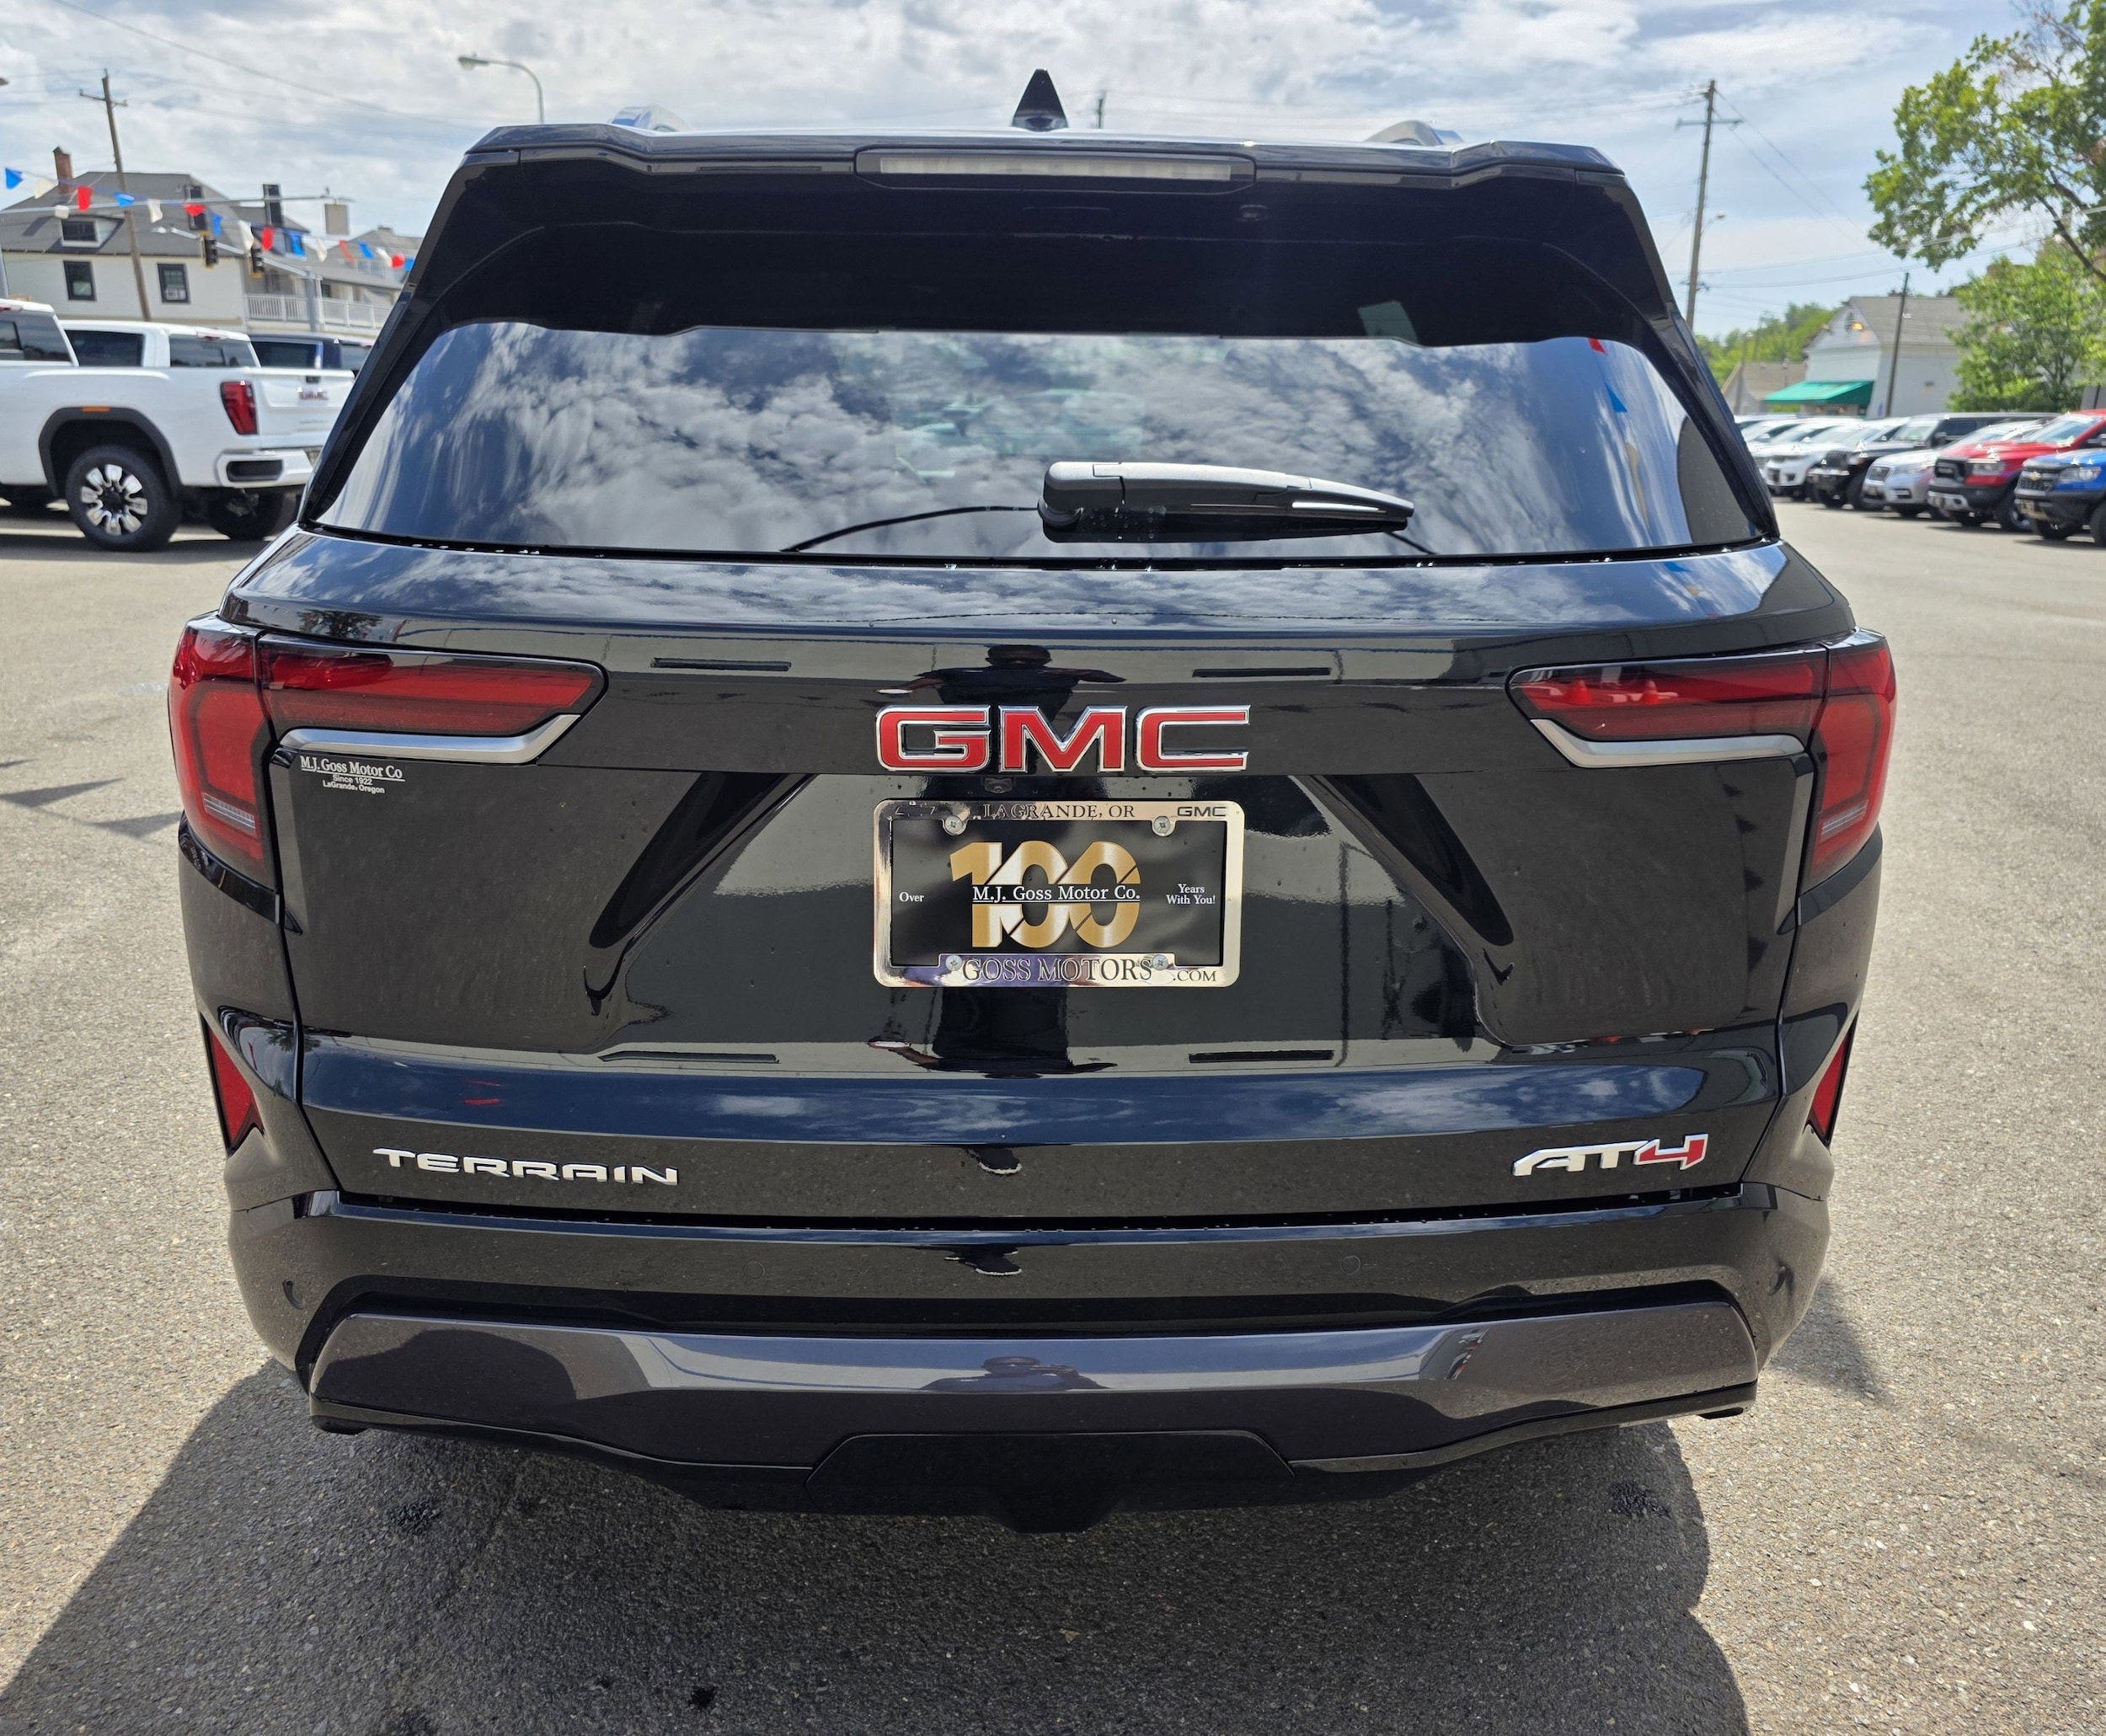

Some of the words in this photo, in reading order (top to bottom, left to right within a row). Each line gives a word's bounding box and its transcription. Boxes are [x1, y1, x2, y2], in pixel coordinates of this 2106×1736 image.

[875, 704, 1251, 773] GMC
[300, 756, 320, 772] M.J.
[321, 758, 347, 773] Goss
[349, 761, 383, 777] Motor
[385, 765, 403, 779] Co
[332, 774, 353, 783] Since
[355, 777, 373, 786] 1922
[358, 784, 385, 794] Oregon
[1109, 804, 1136, 818] OR
[1177, 806, 1227, 817] GMC
[949, 840, 1141, 948] 100
[972, 886, 1007, 904] M.J.
[1013, 887, 1052, 900] Goss
[1058, 885, 1109, 900] Motor
[1114, 885, 1141, 900] Co.
[1178, 883, 1205, 894] Years
[899, 892, 924, 903] Over
[1166, 894, 1190, 905] With
[1194, 894, 1216, 905] You!
[962, 957, 1032, 982] GOSS
[1037, 957, 1153, 982] MOTORS
[1513, 1133, 1708, 1177] AT4
[372, 1147, 678, 1186] TERRAIN
